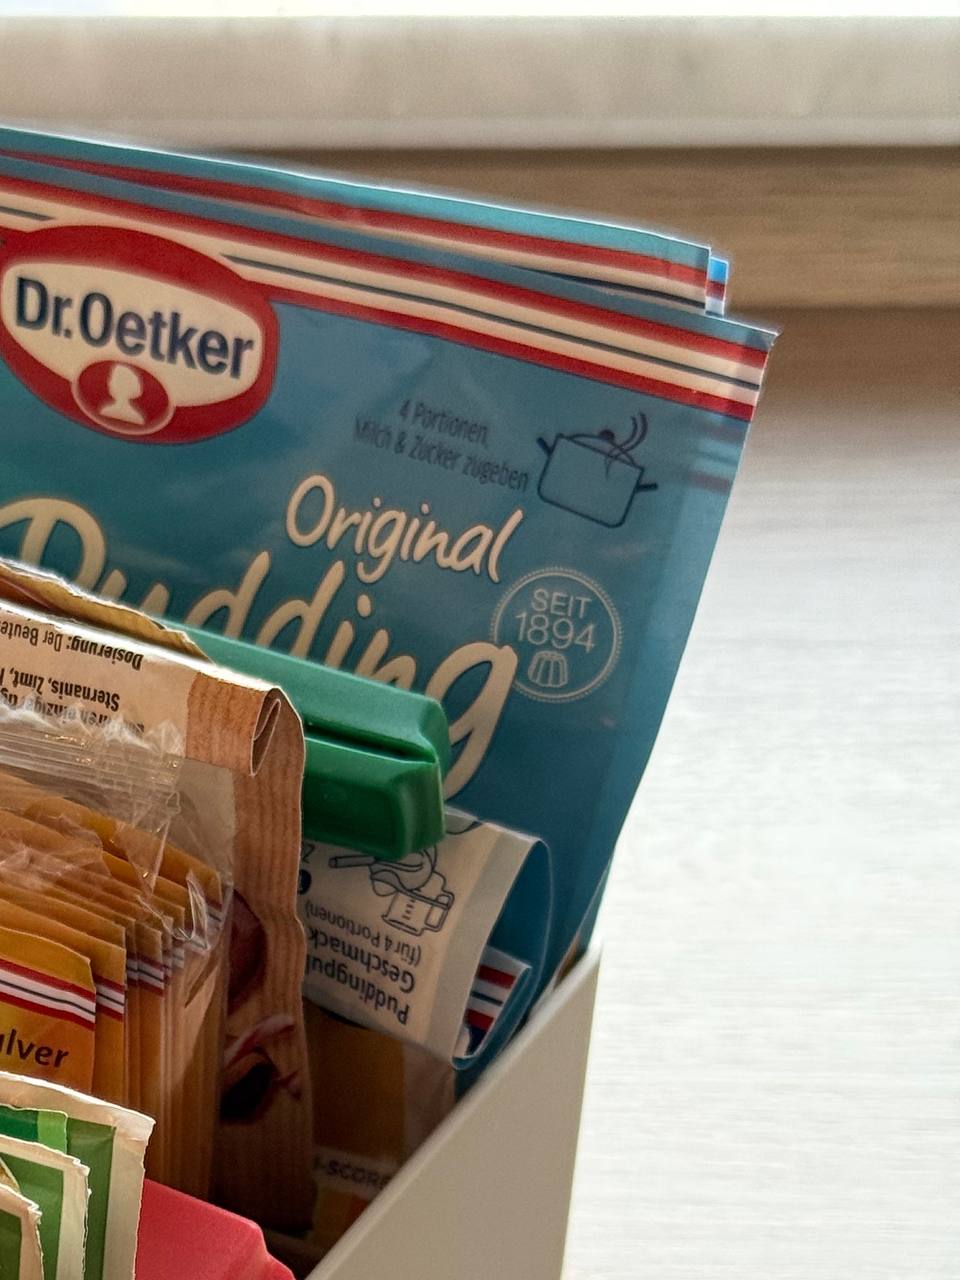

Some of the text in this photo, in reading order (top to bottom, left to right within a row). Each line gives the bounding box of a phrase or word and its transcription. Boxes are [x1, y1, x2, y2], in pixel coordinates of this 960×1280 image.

[400, 399, 412, 421] 4
[353, 416, 530, 493] Milch & Zucker zugeben
[286, 475, 523, 584] Original
[531, 588, 592, 619] SEIT
[42, 630, 63, 652] Der
[516, 612, 595, 653] 1894
[66, 636, 145, 671] Dosierung:
[9, 667, 45, 695] Zimt,
[47, 677, 121, 712] Sternanis,
[305, 900, 380, 947] Portionen)
[309, 927, 416, 994] Geschmack
[393, 943, 422, 967] (für
